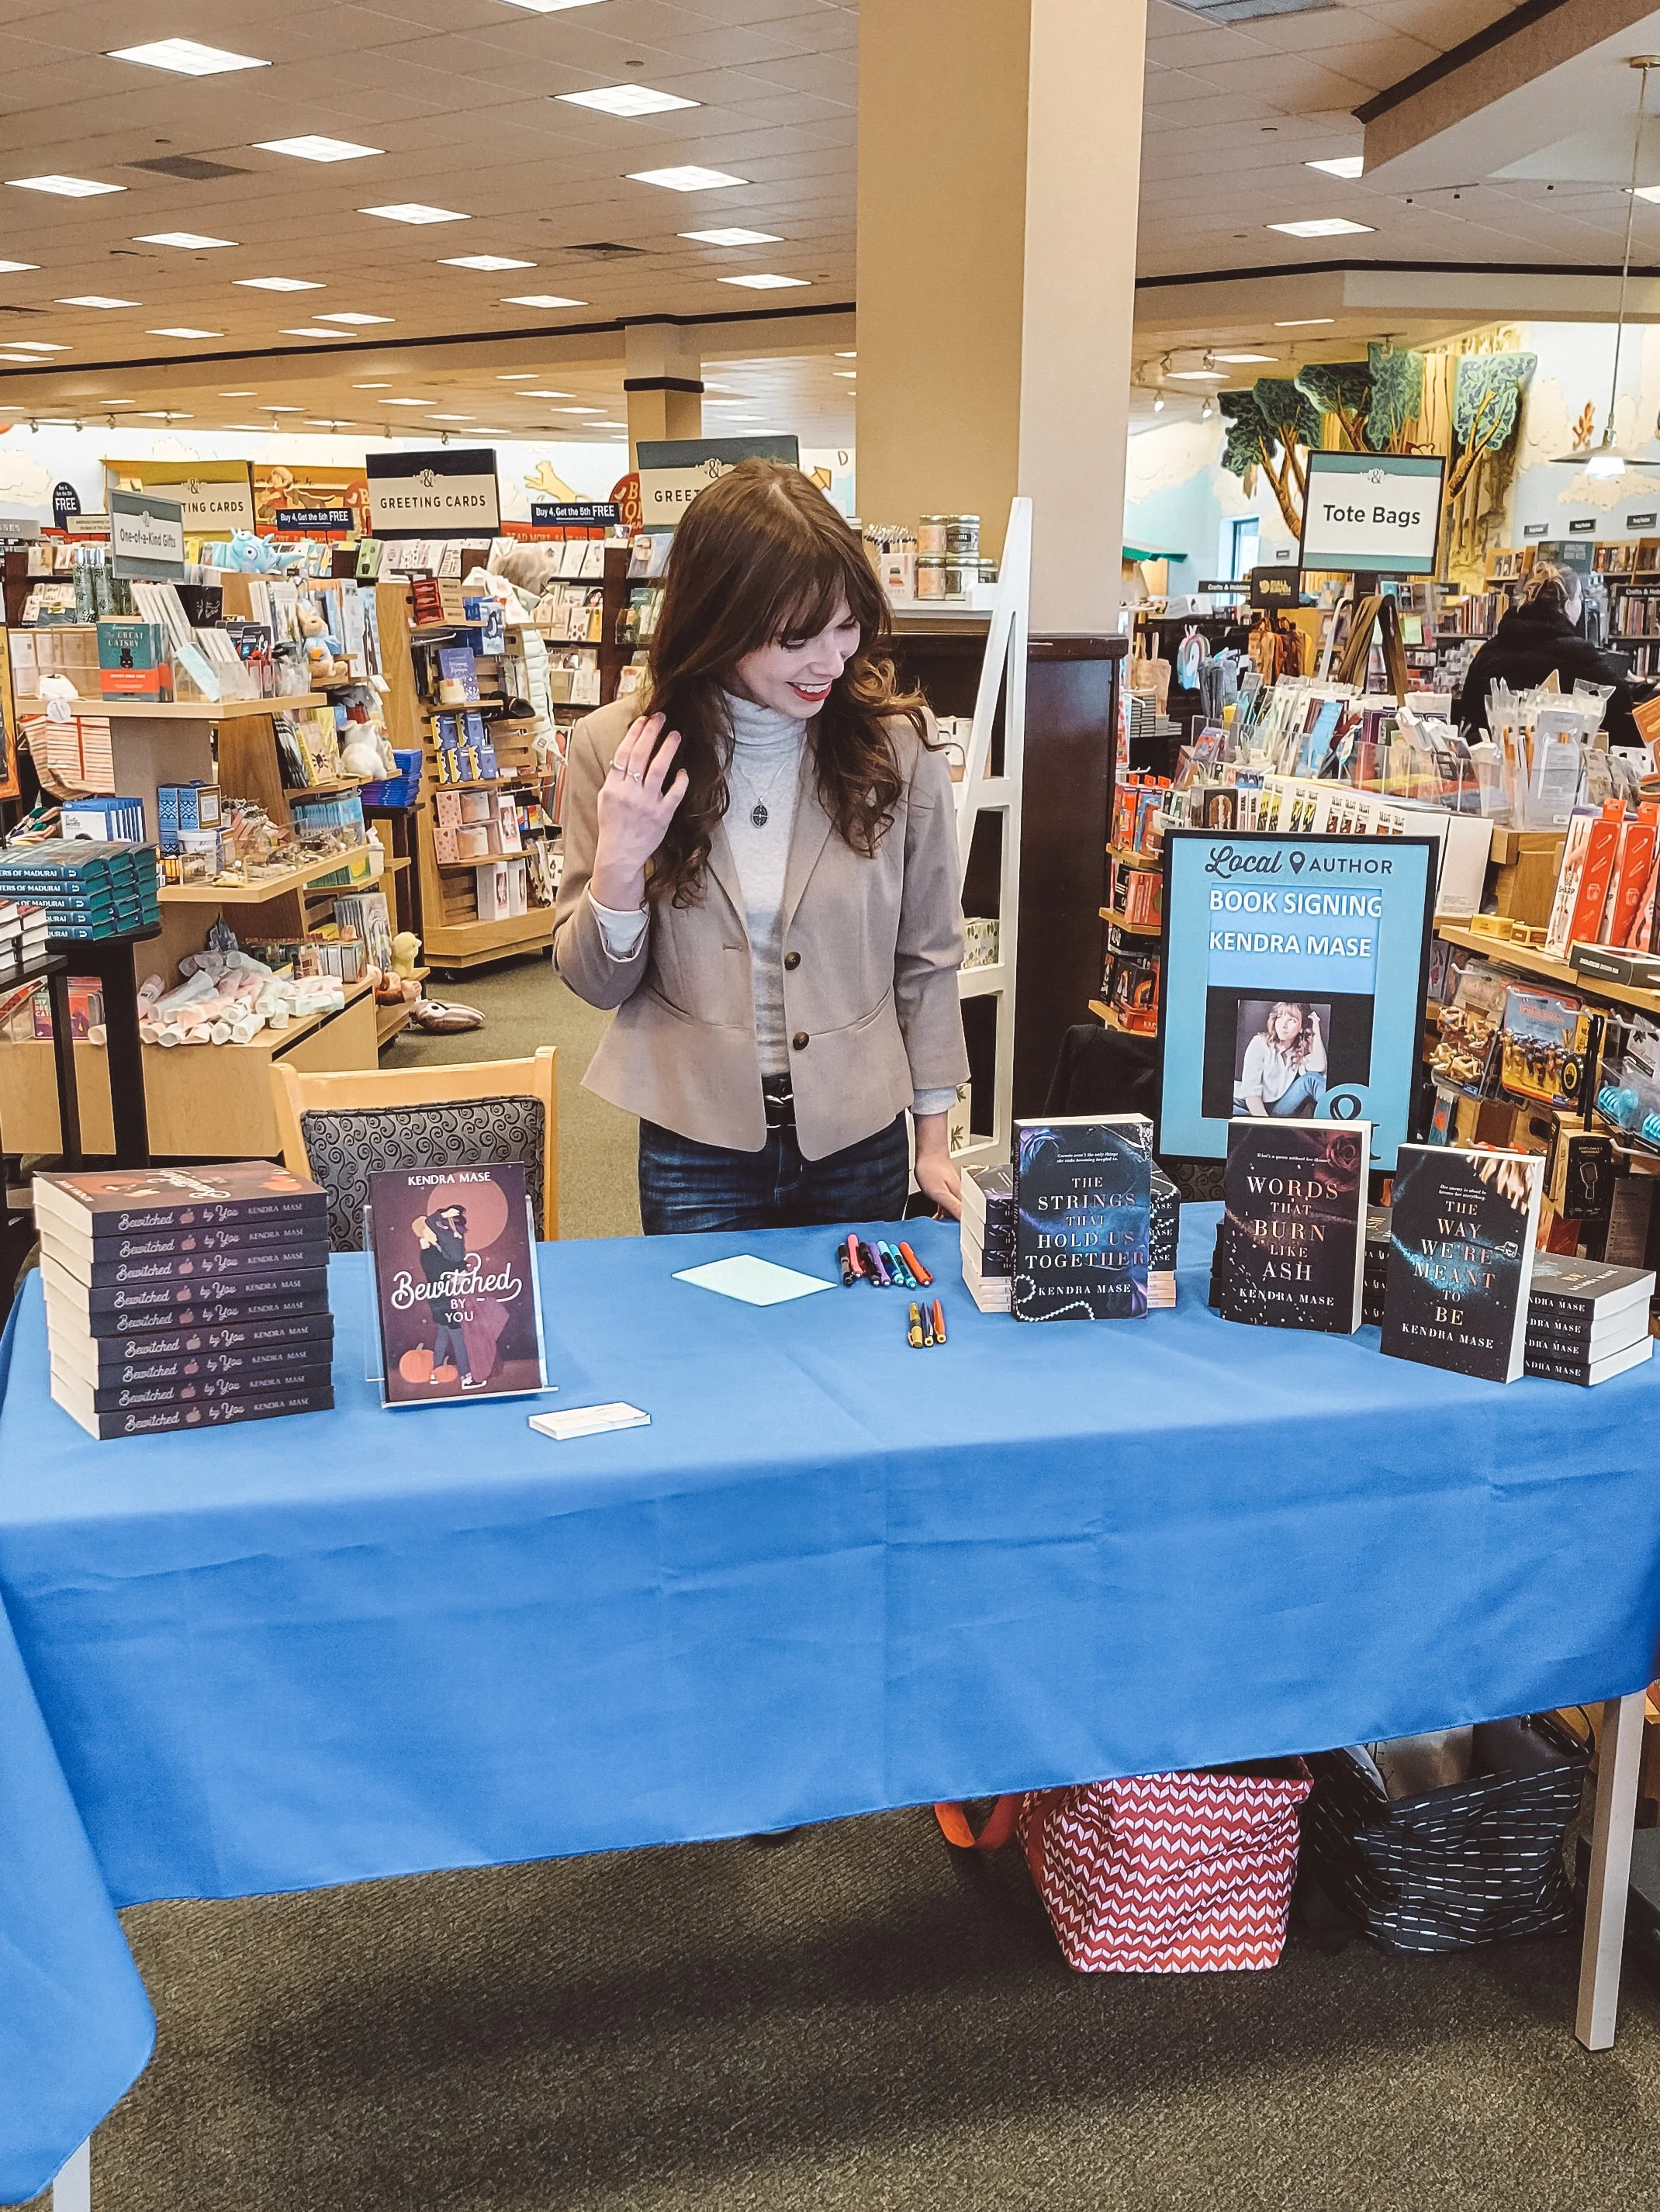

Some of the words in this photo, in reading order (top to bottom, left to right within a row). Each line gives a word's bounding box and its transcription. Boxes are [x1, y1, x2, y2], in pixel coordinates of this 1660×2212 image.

[55, 497, 77, 510] FREE
[380, 496, 441, 509] GREETING
[446, 495, 486, 507] CARDS
[654, 489, 701, 503] GREET
[182, 503, 206, 513] TING
[210, 501, 244, 512] CARDS
[329, 511, 349, 521] FREE
[593, 505, 614, 517] FREE
[1323, 504, 1365, 522] Tote
[1372, 506, 1420, 527] Bags
[120, 528, 161, 547] One-of-a-Kind
[163, 535, 176, 548] Gifts
[1205, 845, 1282, 879] Local
[1309, 859, 1392, 875] AUTHOR
[1210, 890, 1277, 914] BOOK
[1283, 893, 1382, 918] SIGNING
[1209, 931, 1300, 955] KENDRA
[1307, 935, 1372, 958] MASE
[407, 1175, 455, 1187] KENDRA
[459, 1171, 491, 1184] MASE
[1071, 1177, 1103, 1188] THE
[1247, 1175, 1339, 1200] WORDS
[1038, 1193, 1136, 1211] STRINGS
[1270, 1201, 1312, 1215] THAT
[1445, 1201, 1478, 1216] THE
[118, 1212, 174, 1231] Bewitched
[216, 1205, 238, 1221] You
[247, 1205, 279, 1215] KENDRA
[282, 1203, 303, 1211] MASE
[1066, 1215, 1105, 1227] THAT
[1254, 1219, 1326, 1242] BURN
[1437, 1218, 1482, 1239] WAY
[119, 1239, 175, 1258] Bewitched
[216, 1231, 240, 1246] You
[249, 1231, 280, 1241] KENDRA
[283, 1228, 304, 1236] MASE
[1037, 1233, 1098, 1249] HOLD
[1110, 1231, 1134, 1245] US
[1025, 1251, 1144, 1270] TOGETHER
[1270, 1244, 1309, 1258] LIKE
[1420, 1239, 1493, 1265] WE'RE
[116, 1263, 172, 1281] Bewitched
[215, 1254, 238, 1270] You
[247, 1255, 279, 1265] KENDRA
[282, 1252, 304, 1261] MASE
[1262, 1260, 1313, 1281] ASH
[1413, 1262, 1496, 1289] MEANT
[391, 1252, 523, 1310] Bewitched
[1039, 1285, 1091, 1296] KENDRA
[1097, 1284, 1132, 1294] MASE
[113, 1289, 170, 1308] Bewitched
[212, 1281, 237, 1297] You
[245, 1282, 277, 1291] KENDRA
[280, 1279, 302, 1287] MASE
[1240, 1287, 1294, 1302] KENDRA
[1299, 1294, 1335, 1307] MASE
[1442, 1289, 1461, 1302] TO
[451, 1298, 465, 1310] BY
[1529, 1296, 1554, 1307] NDRA
[1558, 1301, 1586, 1312] MASE
[117, 1312, 173, 1331] Bewitched
[214, 1304, 238, 1320] You
[247, 1304, 279, 1313] KENDRA
[282, 1301, 304, 1309] MASE
[444, 1311, 474, 1323] YOU
[1435, 1306, 1465, 1325] BE
[1527, 1318, 1550, 1328] DRA
[1554, 1322, 1582, 1333] MASE
[124, 1339, 180, 1358] Bewitched
[221, 1330, 245, 1346] You
[254, 1329, 285, 1339] KENDRA
[289, 1326, 310, 1335] MASE
[1402, 1322, 1454, 1342] KENDRA
[1458, 1333, 1495, 1350] MASE
[1525, 1339, 1548, 1349] DRA
[1552, 1343, 1579, 1354] MASE
[123, 1364, 178, 1382] Bewitched
[220, 1354, 243, 1370] You
[251, 1354, 283, 1363] KENDRA
[286, 1350, 308, 1360] MASE
[1525, 1360, 1551, 1371] NDRA
[1555, 1365, 1582, 1377] MASE
[119, 1388, 175, 1406] Bewitched
[216, 1378, 240, 1395] You
[250, 1378, 281, 1388] KENDRA
[285, 1374, 306, 1384] MASE
[124, 1412, 180, 1432] Bewitched
[221, 1402, 245, 1419] You
[254, 1401, 285, 1411] KENDRA
[289, 1397, 310, 1406] MASE
